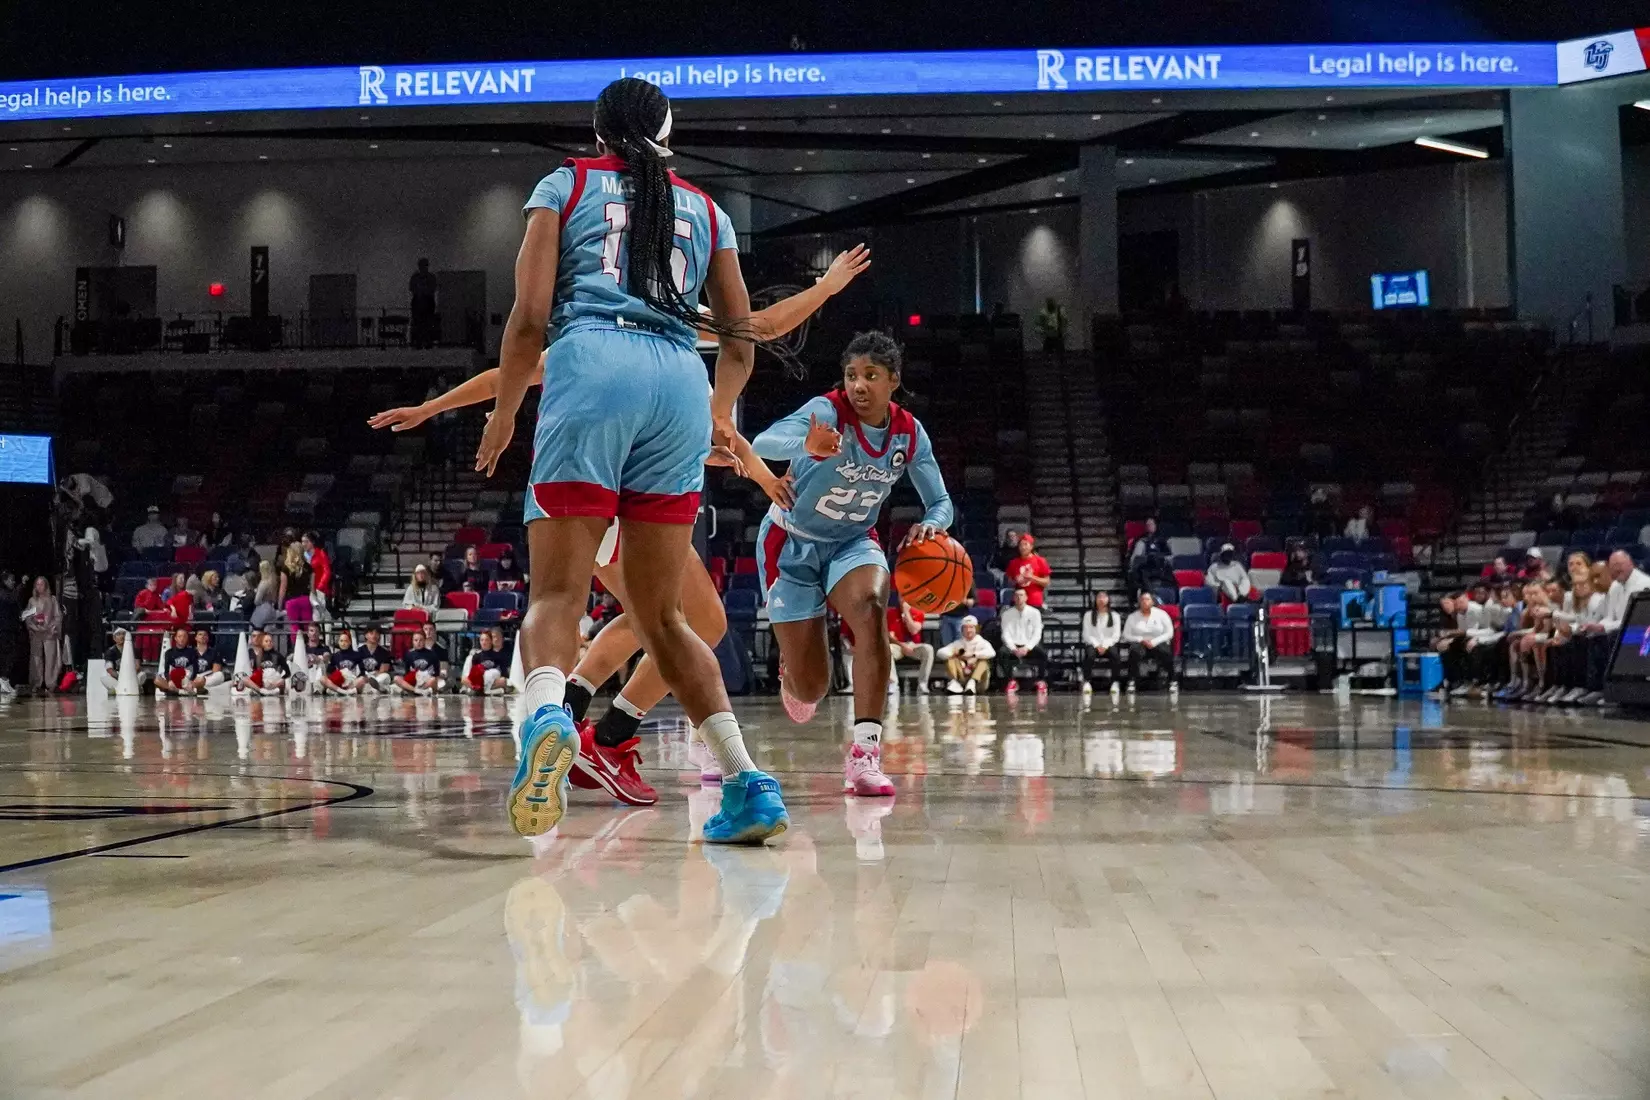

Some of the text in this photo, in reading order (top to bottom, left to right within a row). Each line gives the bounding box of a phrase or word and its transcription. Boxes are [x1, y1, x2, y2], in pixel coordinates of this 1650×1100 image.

[688, 64, 739, 88] help
[745, 63, 762, 83] is
[769, 63, 826, 83] here.
[1075, 53, 1222, 82] RELEVANT
[1308, 51, 1519, 78] Legal help is here.
[45, 85, 91, 108] help
[97, 85, 112, 103] is
[118, 83, 171, 102] here.
[395, 68, 536, 97] RELEVANT
[815, 487, 883, 522] 23
